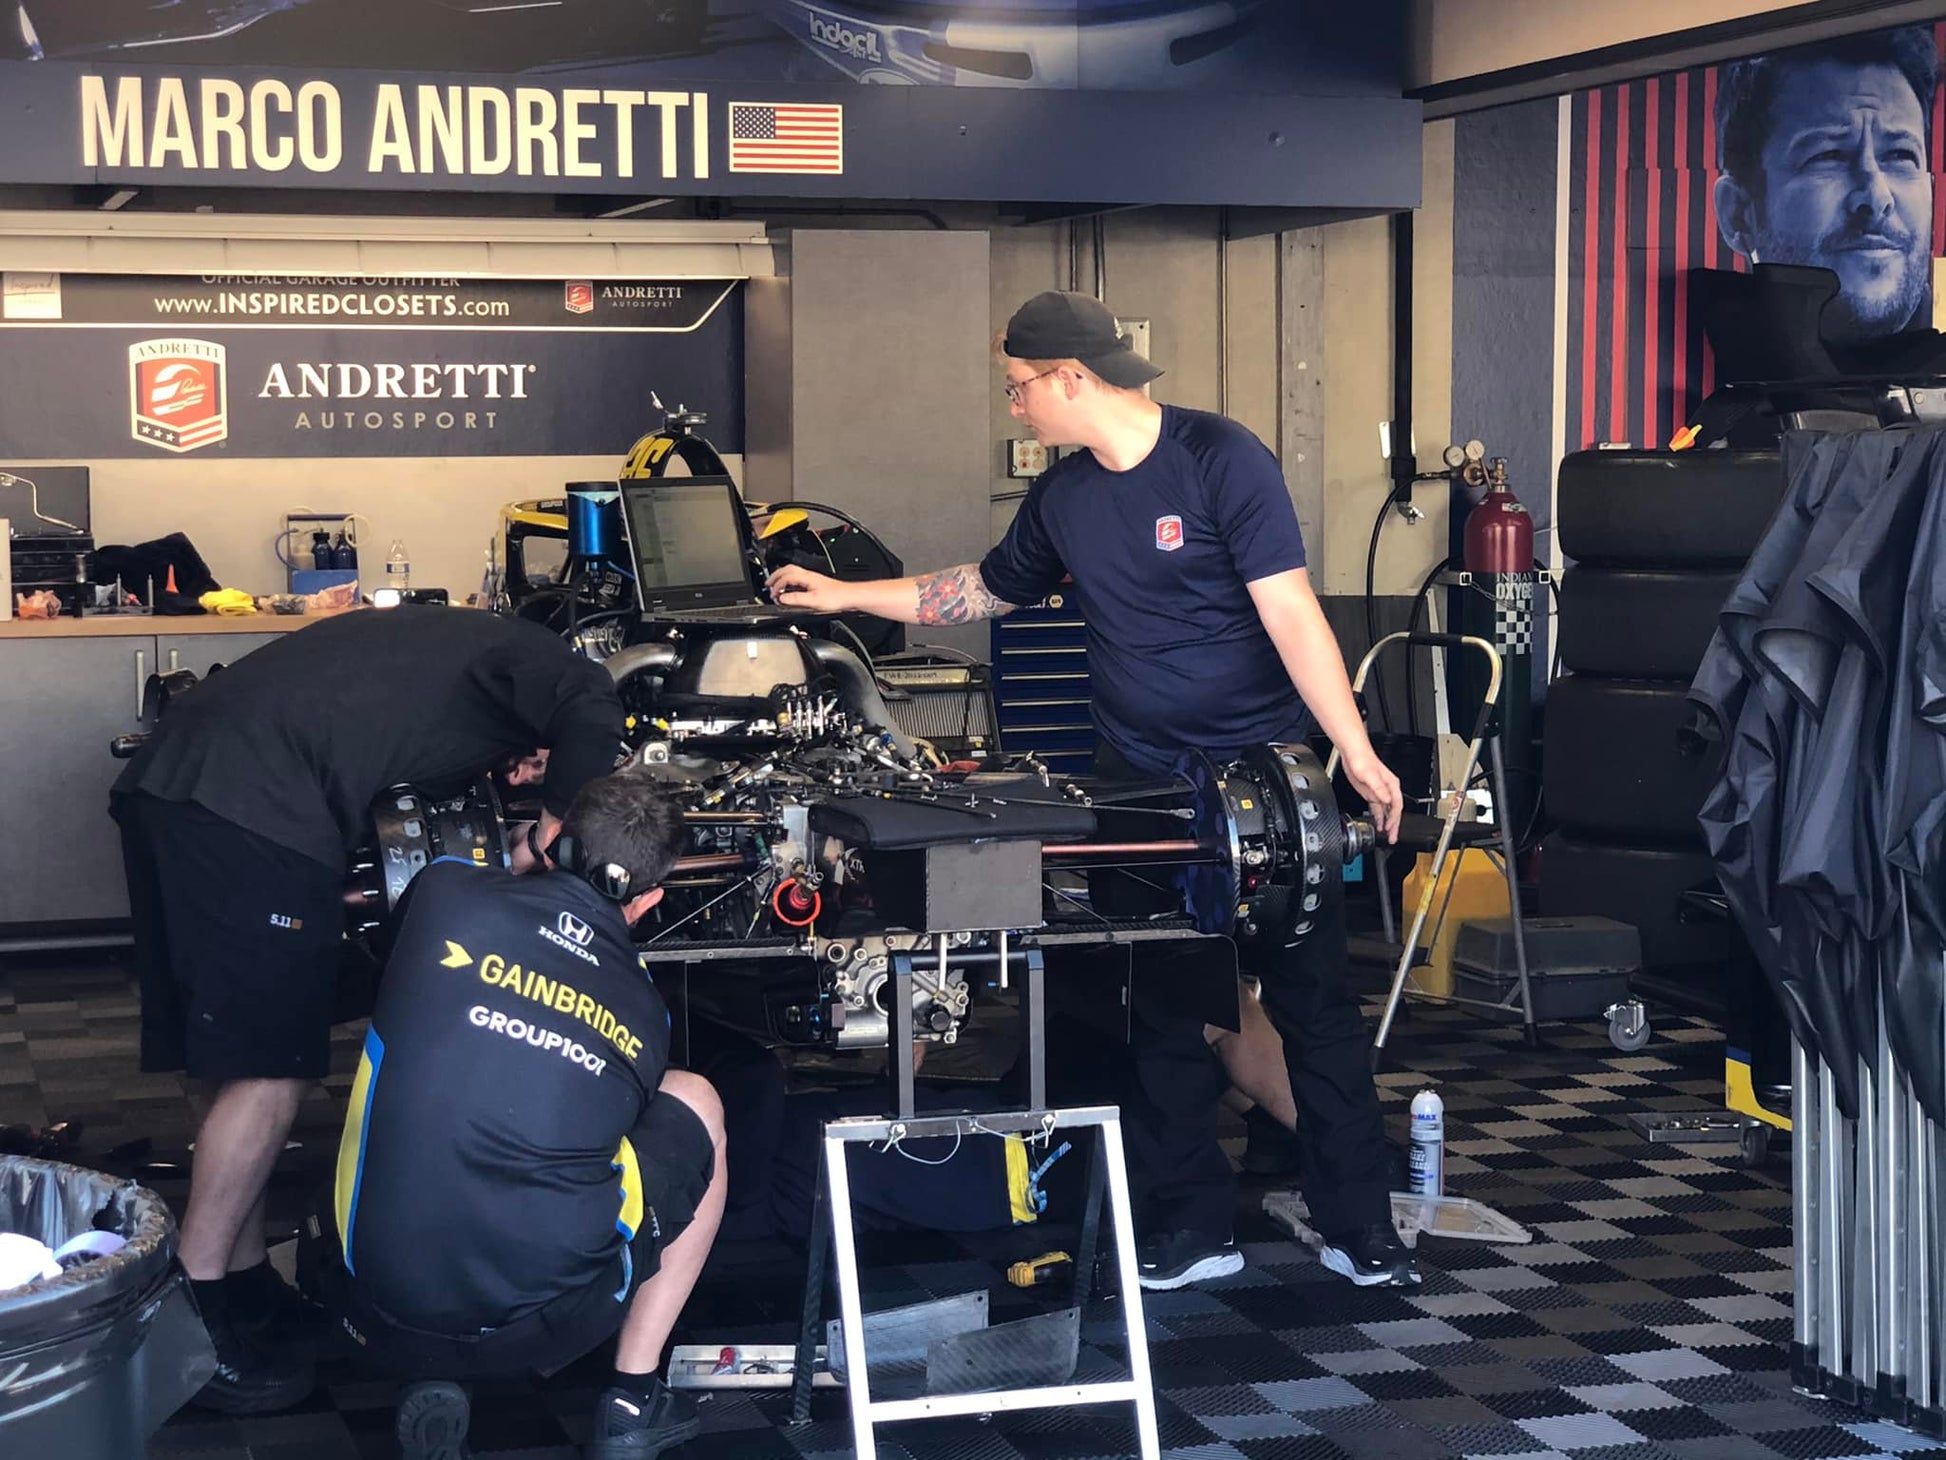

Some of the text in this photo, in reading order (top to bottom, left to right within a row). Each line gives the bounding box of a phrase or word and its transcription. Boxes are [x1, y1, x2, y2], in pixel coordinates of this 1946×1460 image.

[81, 75, 709, 179] MARCO ANDRETTI
[202, 275, 461, 287] OFFICIAL GARAGE OUTFITTER
[602, 286, 682, 299] ANDRETTI
[154, 292, 510, 317] www.INSPIREDCLOSETS.com
[137, 343, 219, 359] ANDRETTI
[294, 411, 497, 430] AUTOSPORT
[538, 925, 600, 967] HONDA
[480, 954, 644, 1060] GAINBRIDGE
[469, 1005, 607, 1077] GROUP1001
